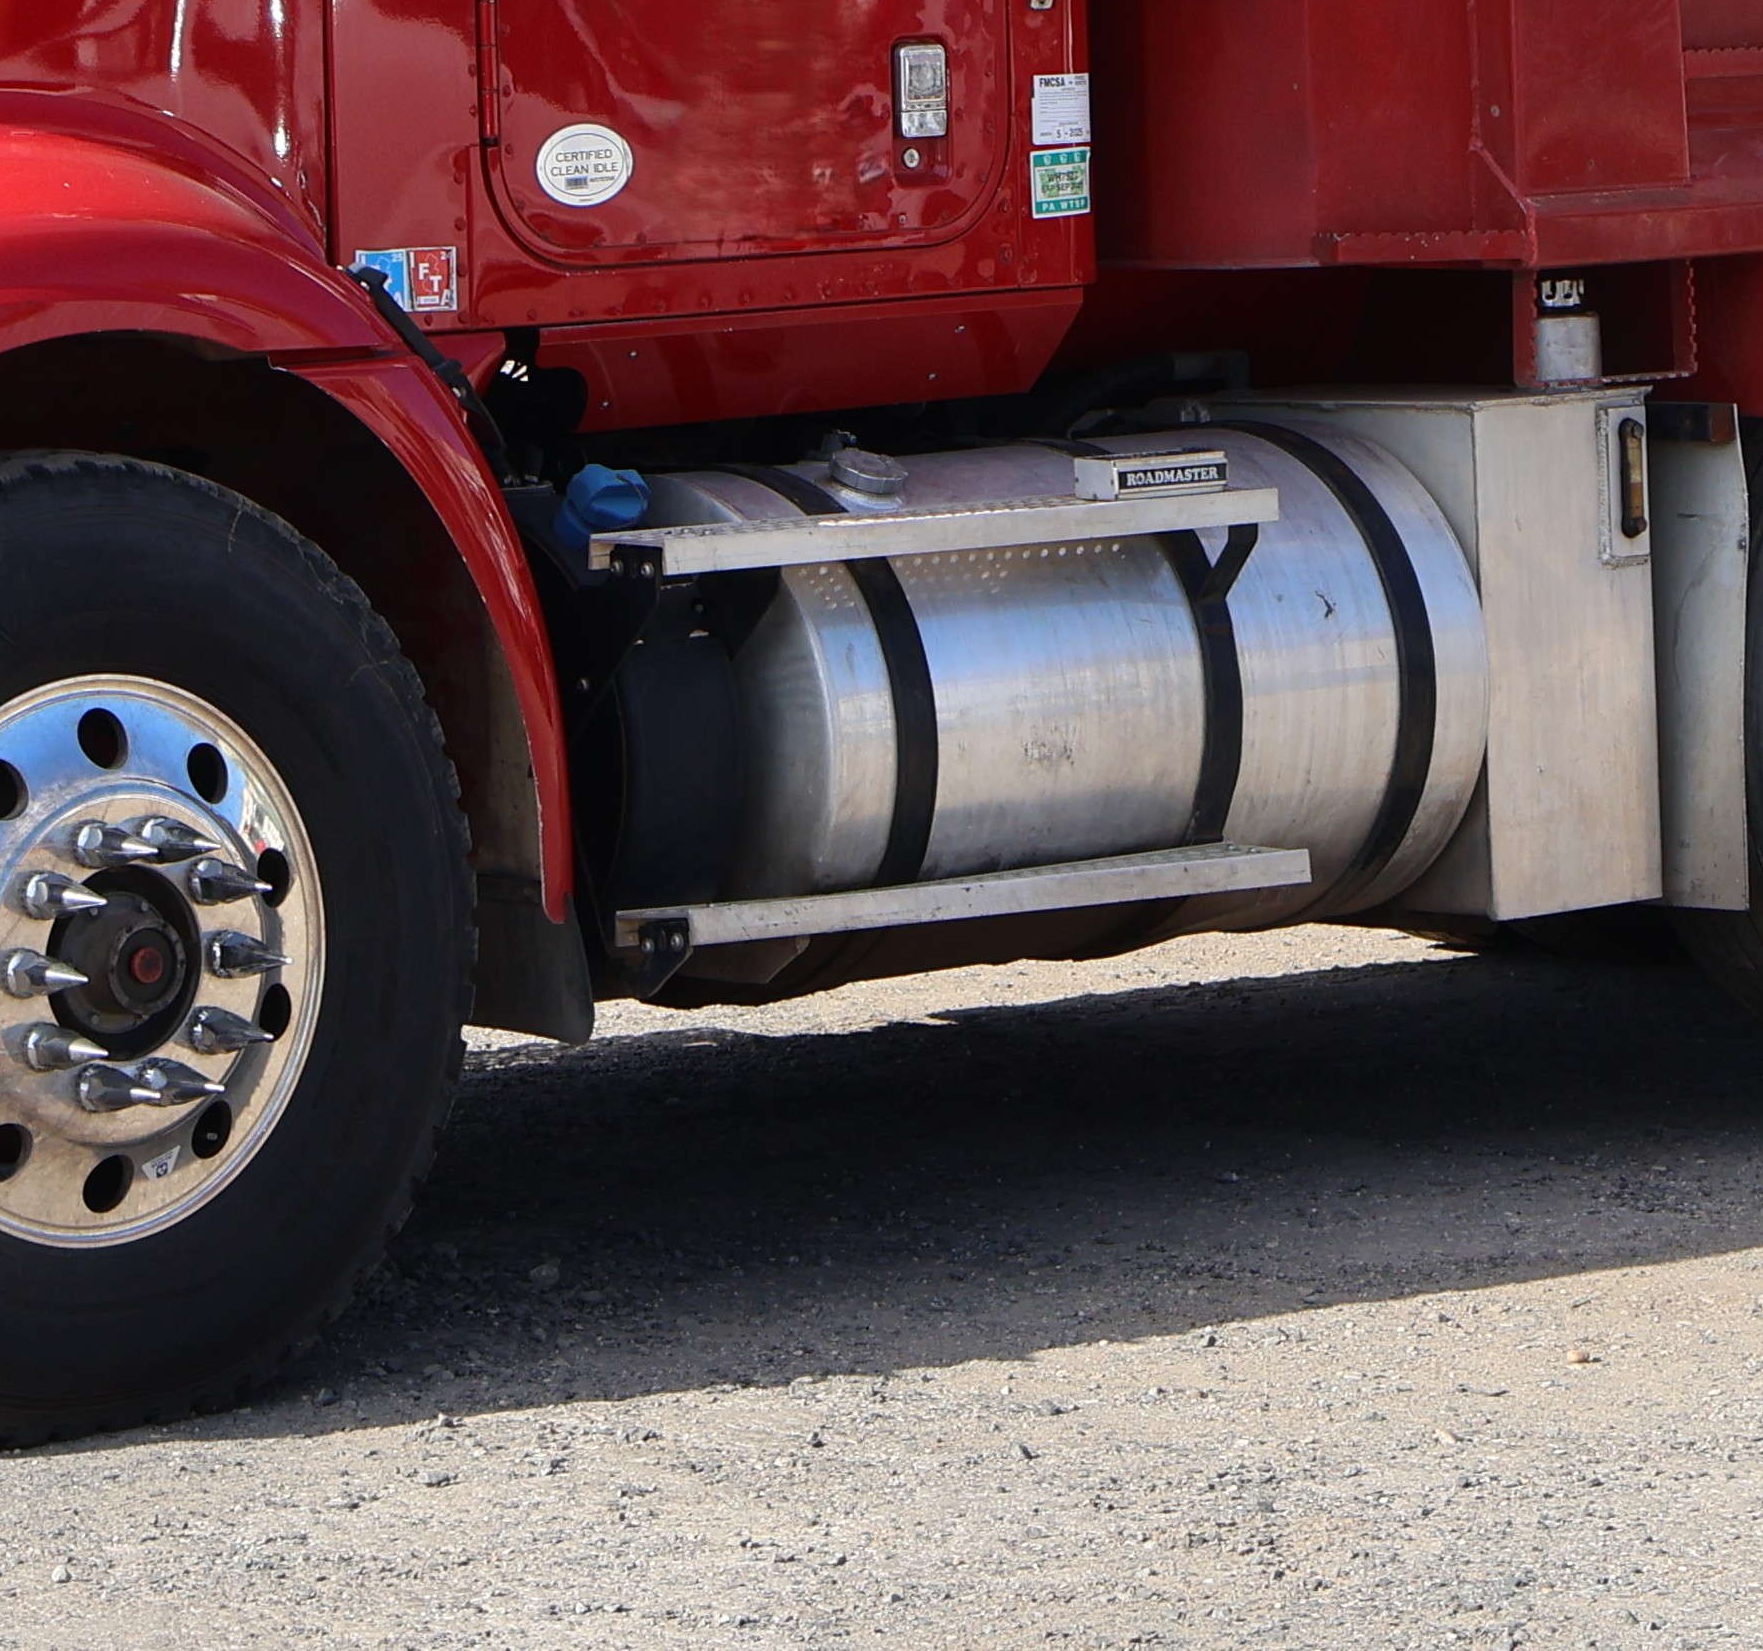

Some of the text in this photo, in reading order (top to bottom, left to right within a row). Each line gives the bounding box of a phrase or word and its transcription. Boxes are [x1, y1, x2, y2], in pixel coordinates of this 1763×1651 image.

[555, 148, 613, 163] CERTIFIED
[550, 161, 619, 177] CLEAN IDLE
[1042, 202, 1056, 212] PA
[391, 253, 404, 263] 25
[1126, 466, 1219, 487] ROADMASTER
